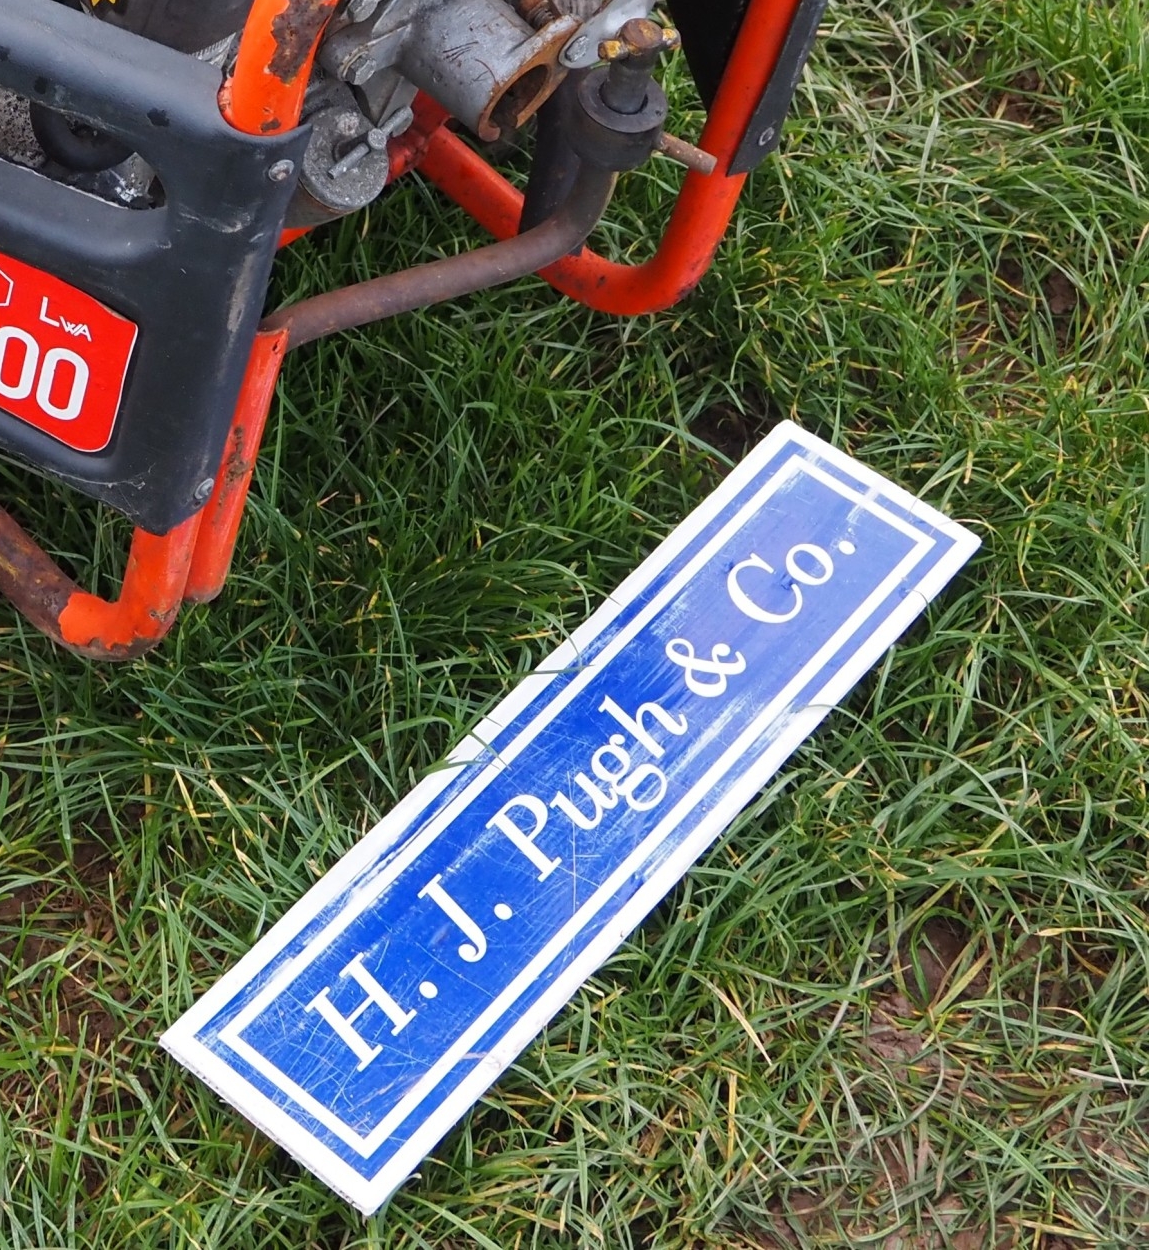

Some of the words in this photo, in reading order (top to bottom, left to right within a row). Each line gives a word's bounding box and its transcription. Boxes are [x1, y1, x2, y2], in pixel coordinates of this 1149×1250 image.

[304, 953, 439, 1072] H.
[417, 873, 515, 963] J.
[485, 695, 688, 884] Pugh
[665, 638, 747, 698] &
[725, 535, 857, 626] Co.
